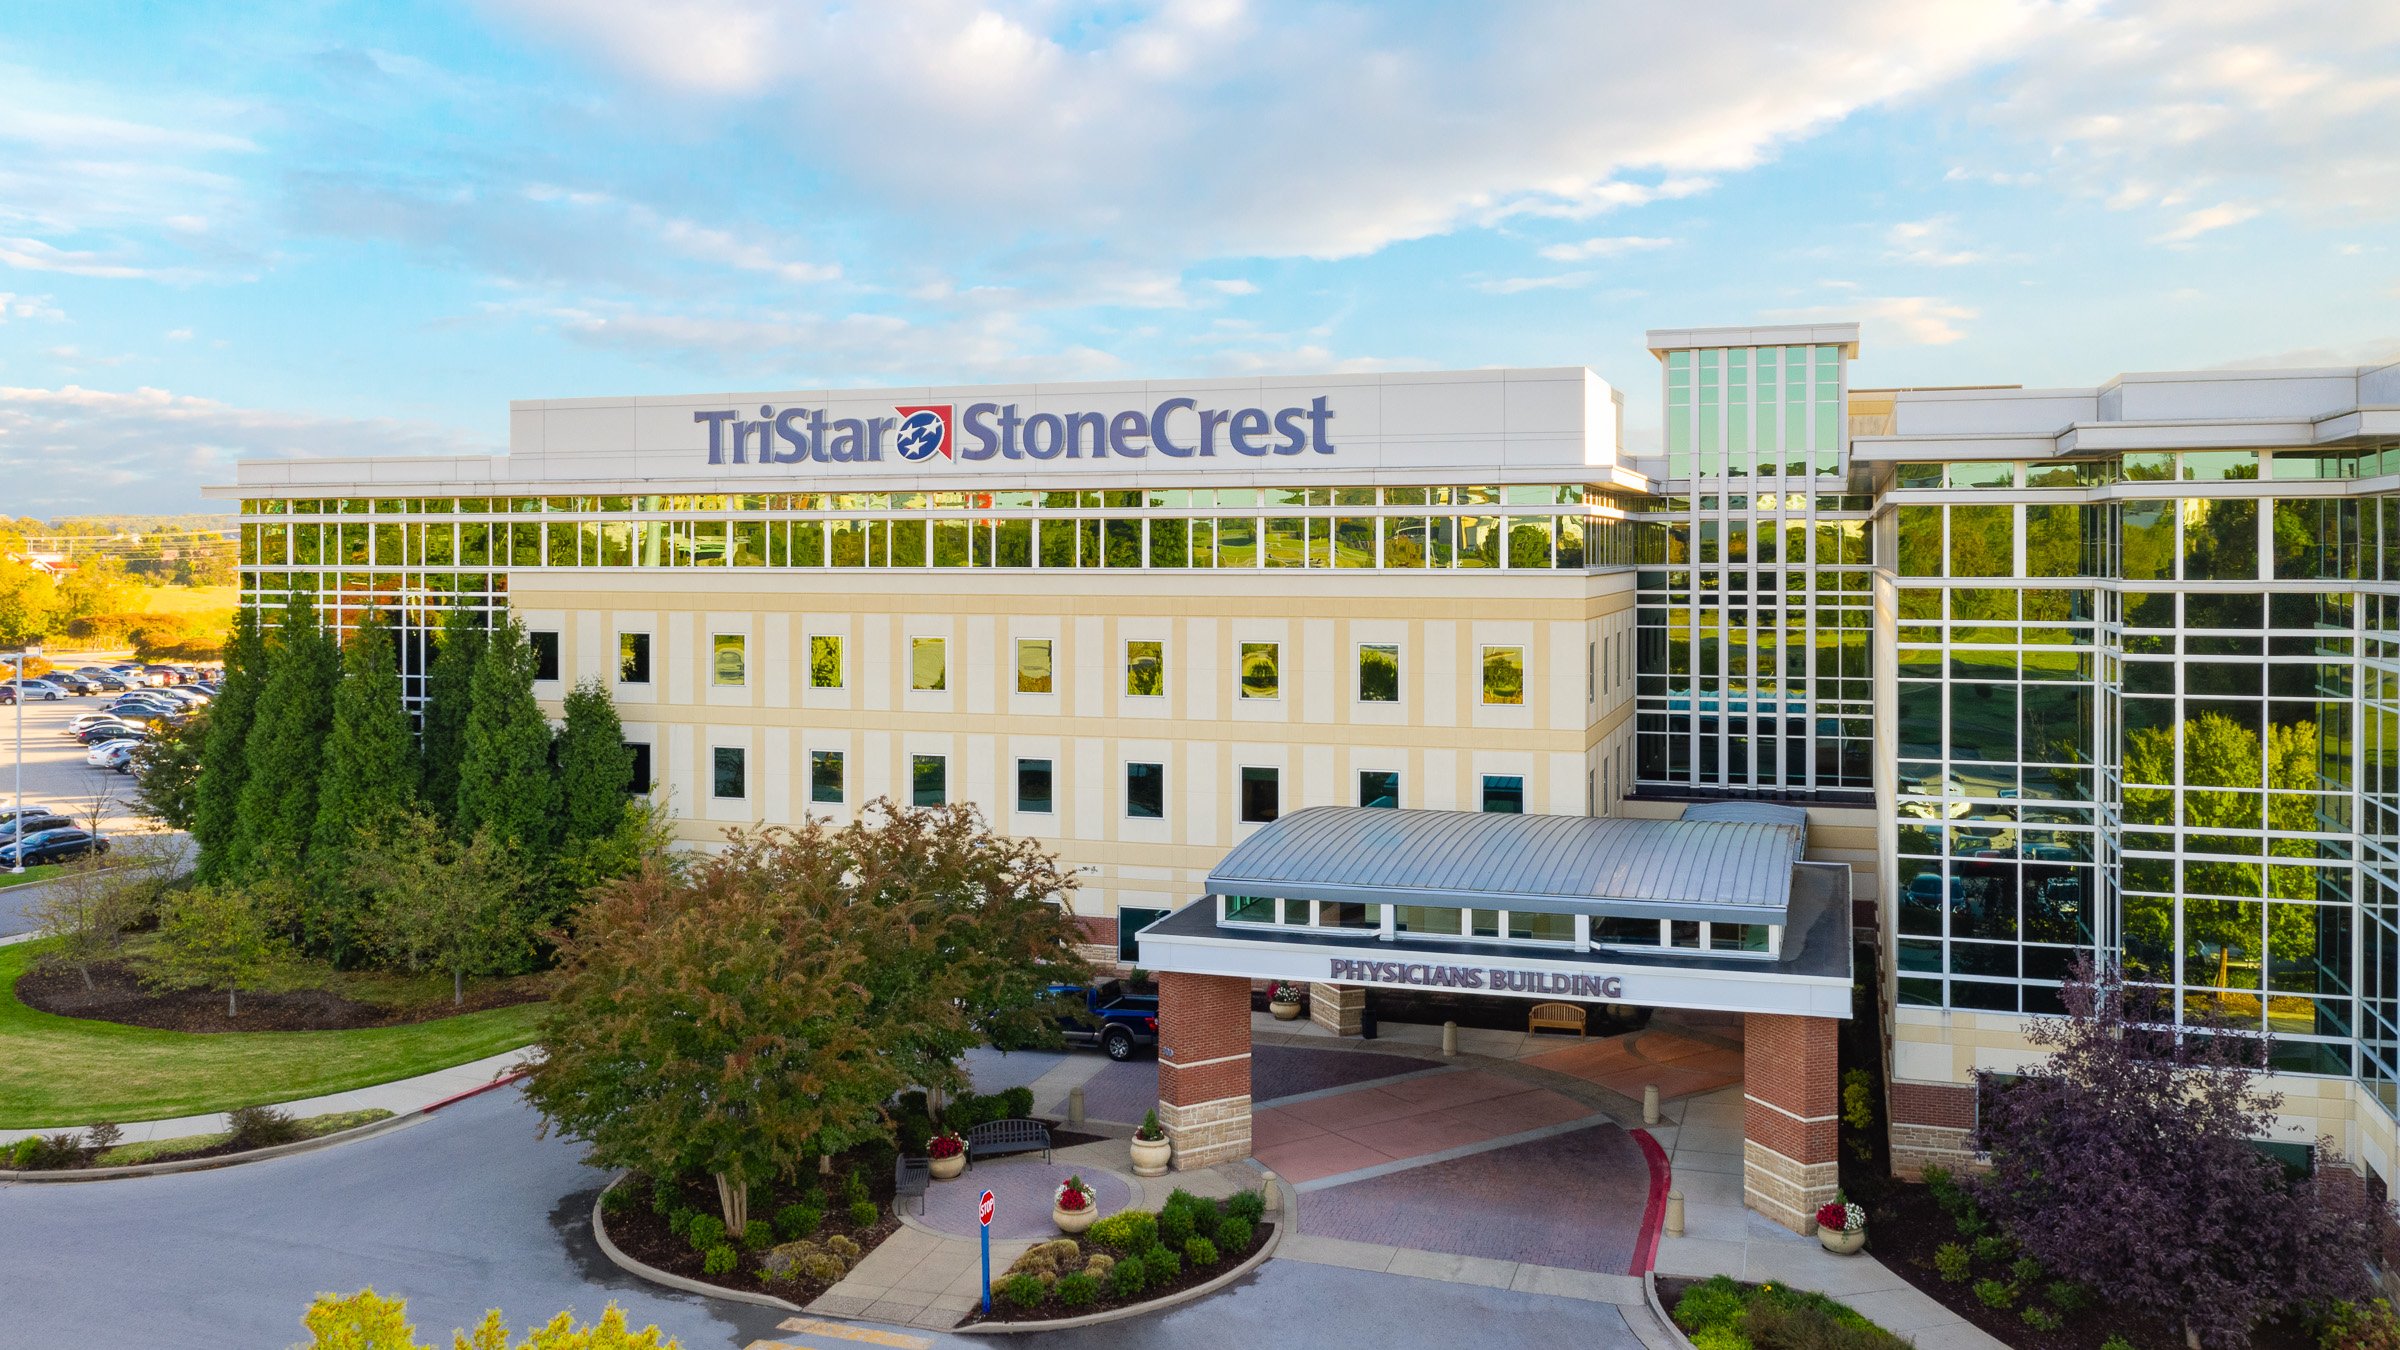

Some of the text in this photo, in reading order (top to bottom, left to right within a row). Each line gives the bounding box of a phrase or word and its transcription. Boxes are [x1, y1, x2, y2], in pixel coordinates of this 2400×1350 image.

[694, 395, 1335, 465] TriStar StoneCrest
[1330, 958, 1621, 998] PHYSICIANS BUILDING
[980, 1198, 993, 1217] STOP
